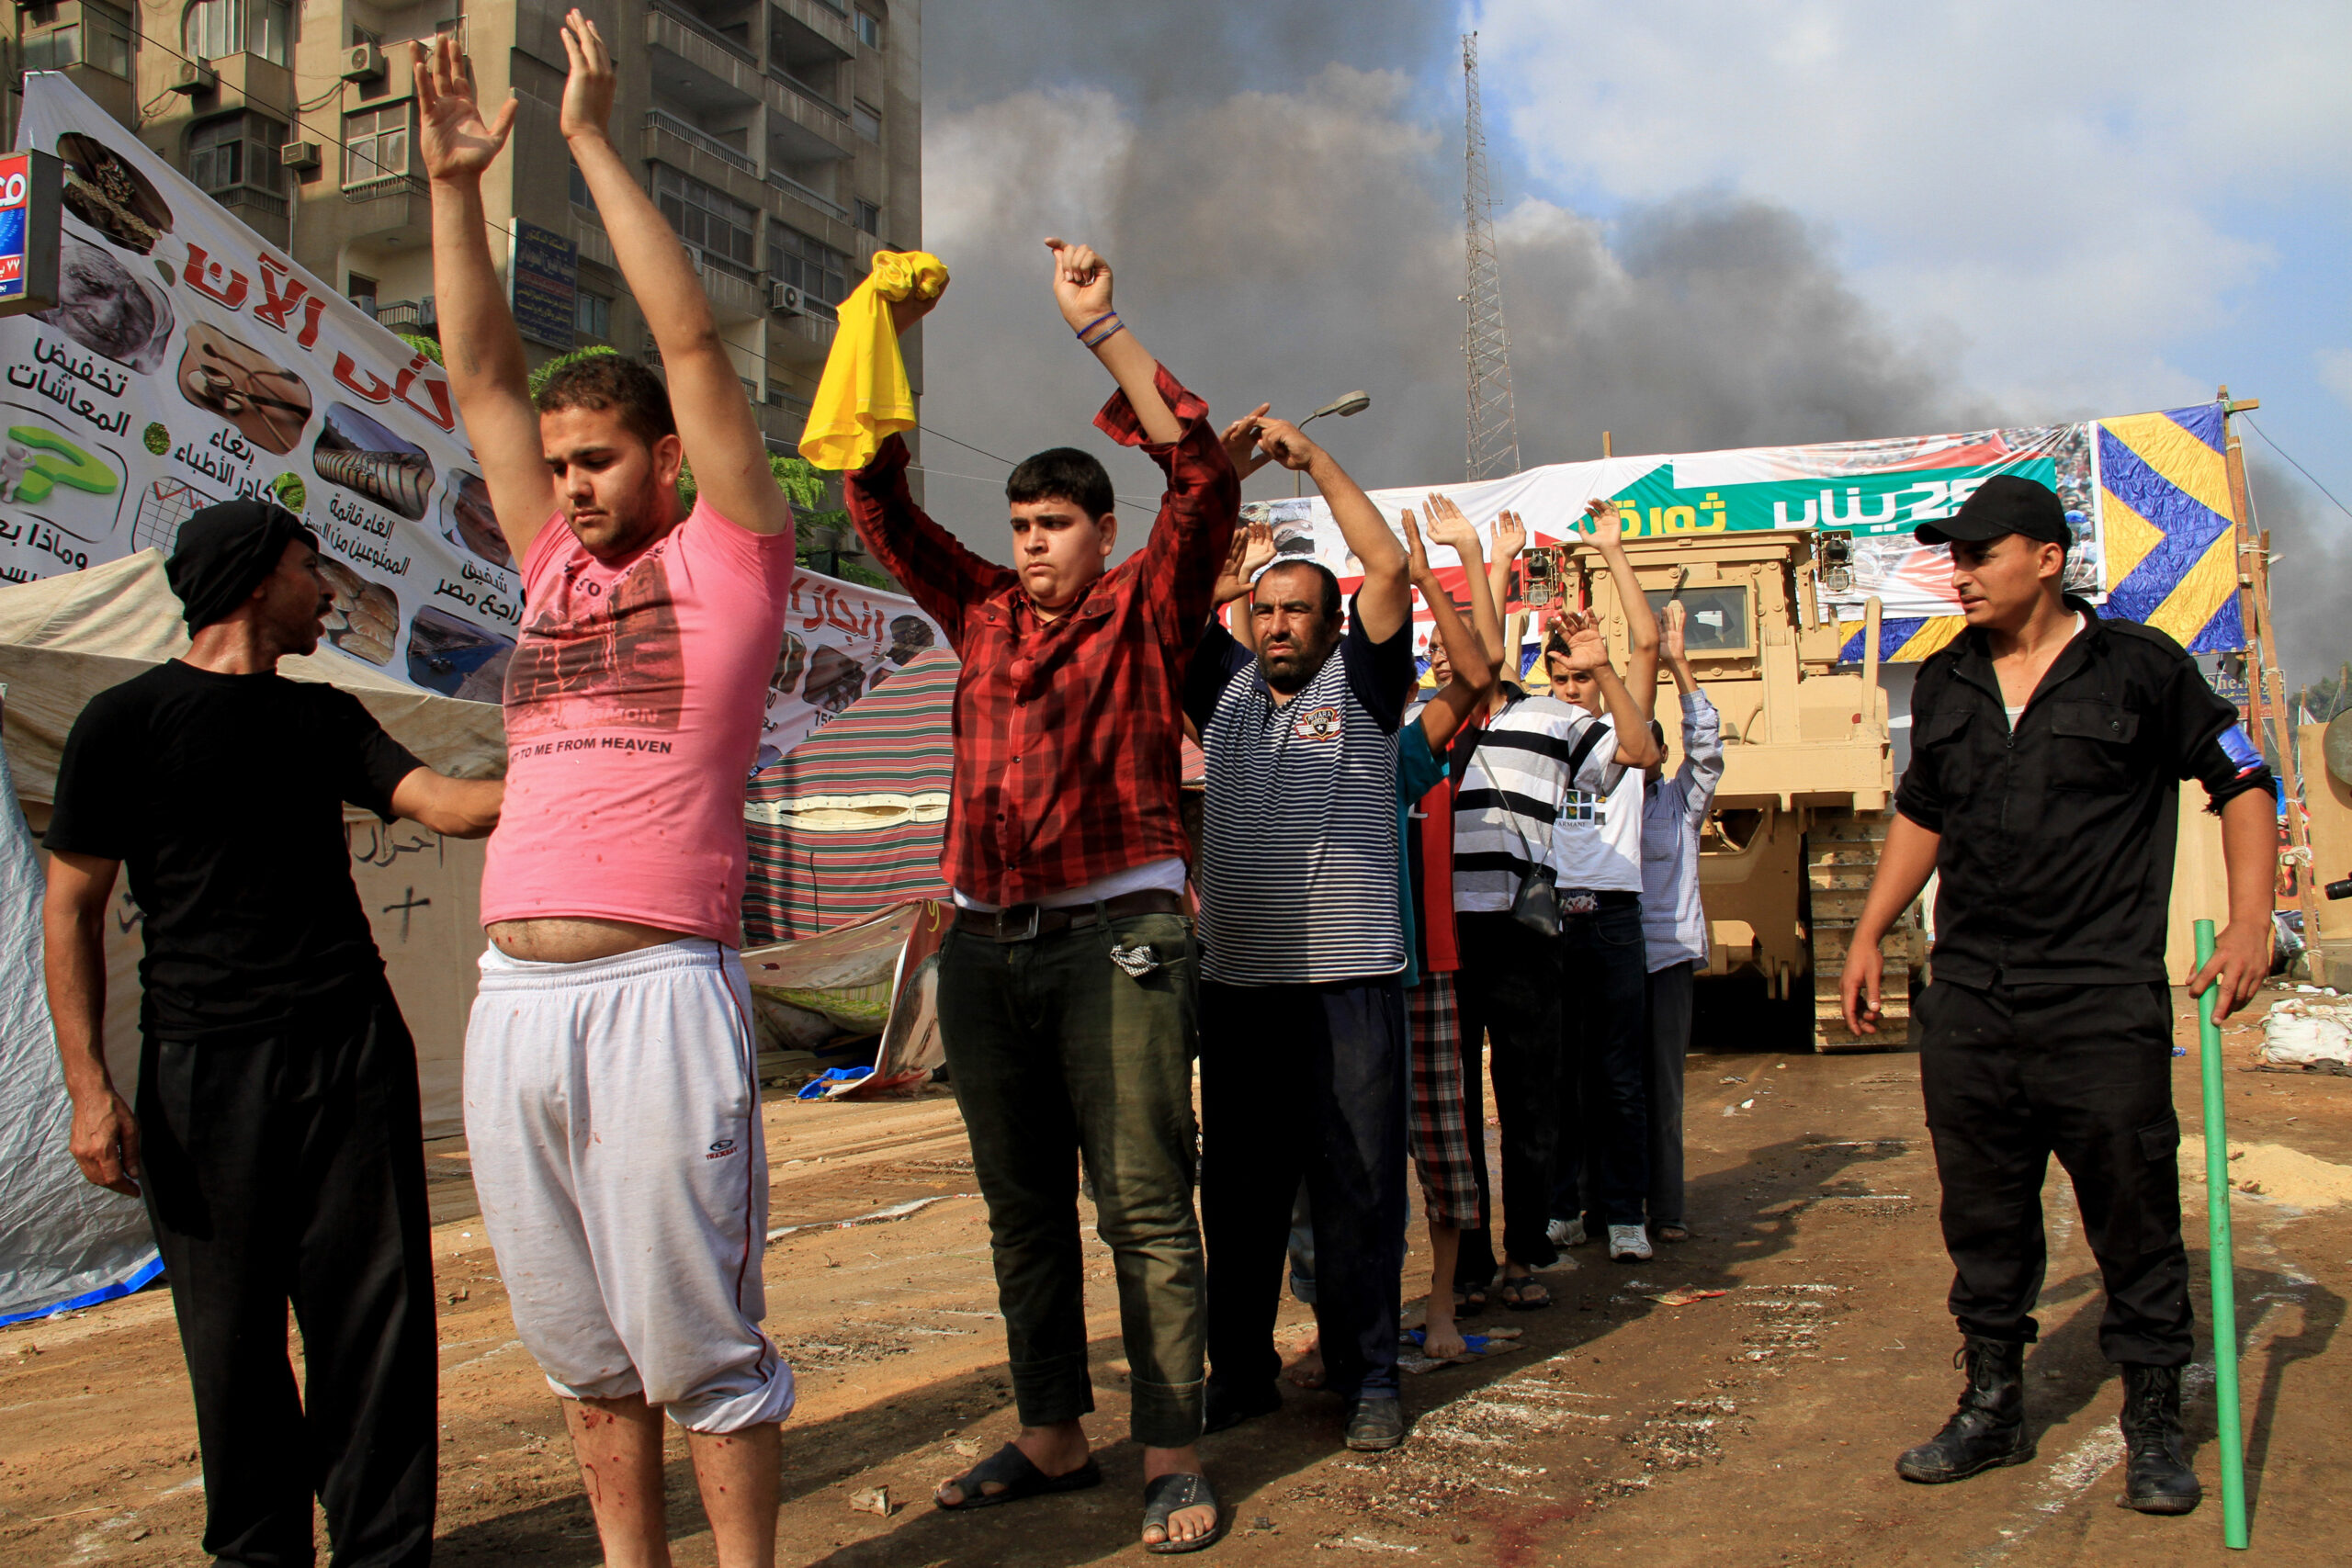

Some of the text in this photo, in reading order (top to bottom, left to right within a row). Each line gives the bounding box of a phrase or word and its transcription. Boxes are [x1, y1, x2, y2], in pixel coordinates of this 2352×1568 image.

[183, 242, 327, 352] الآن
[33, 336, 130, 398] تخفيض
[7, 365, 132, 437] المعاشات
[174, 443, 273, 505] كادر الأطباء
[330, 492, 365, 526] قائمة
[28, 523, 89, 571] وماذا
[304, 512, 411, 577] الممنوعين من السف
[434, 579, 524, 626] راجع مصر
[461, 559, 508, 594] شفيق
[790, 577, 885, 659] إنجازا
[520, 747, 532, 760] TO
[535, 743, 553, 756] ME
[556, 738, 596, 752] FROM
[601, 738, 673, 754] HEAVEN
